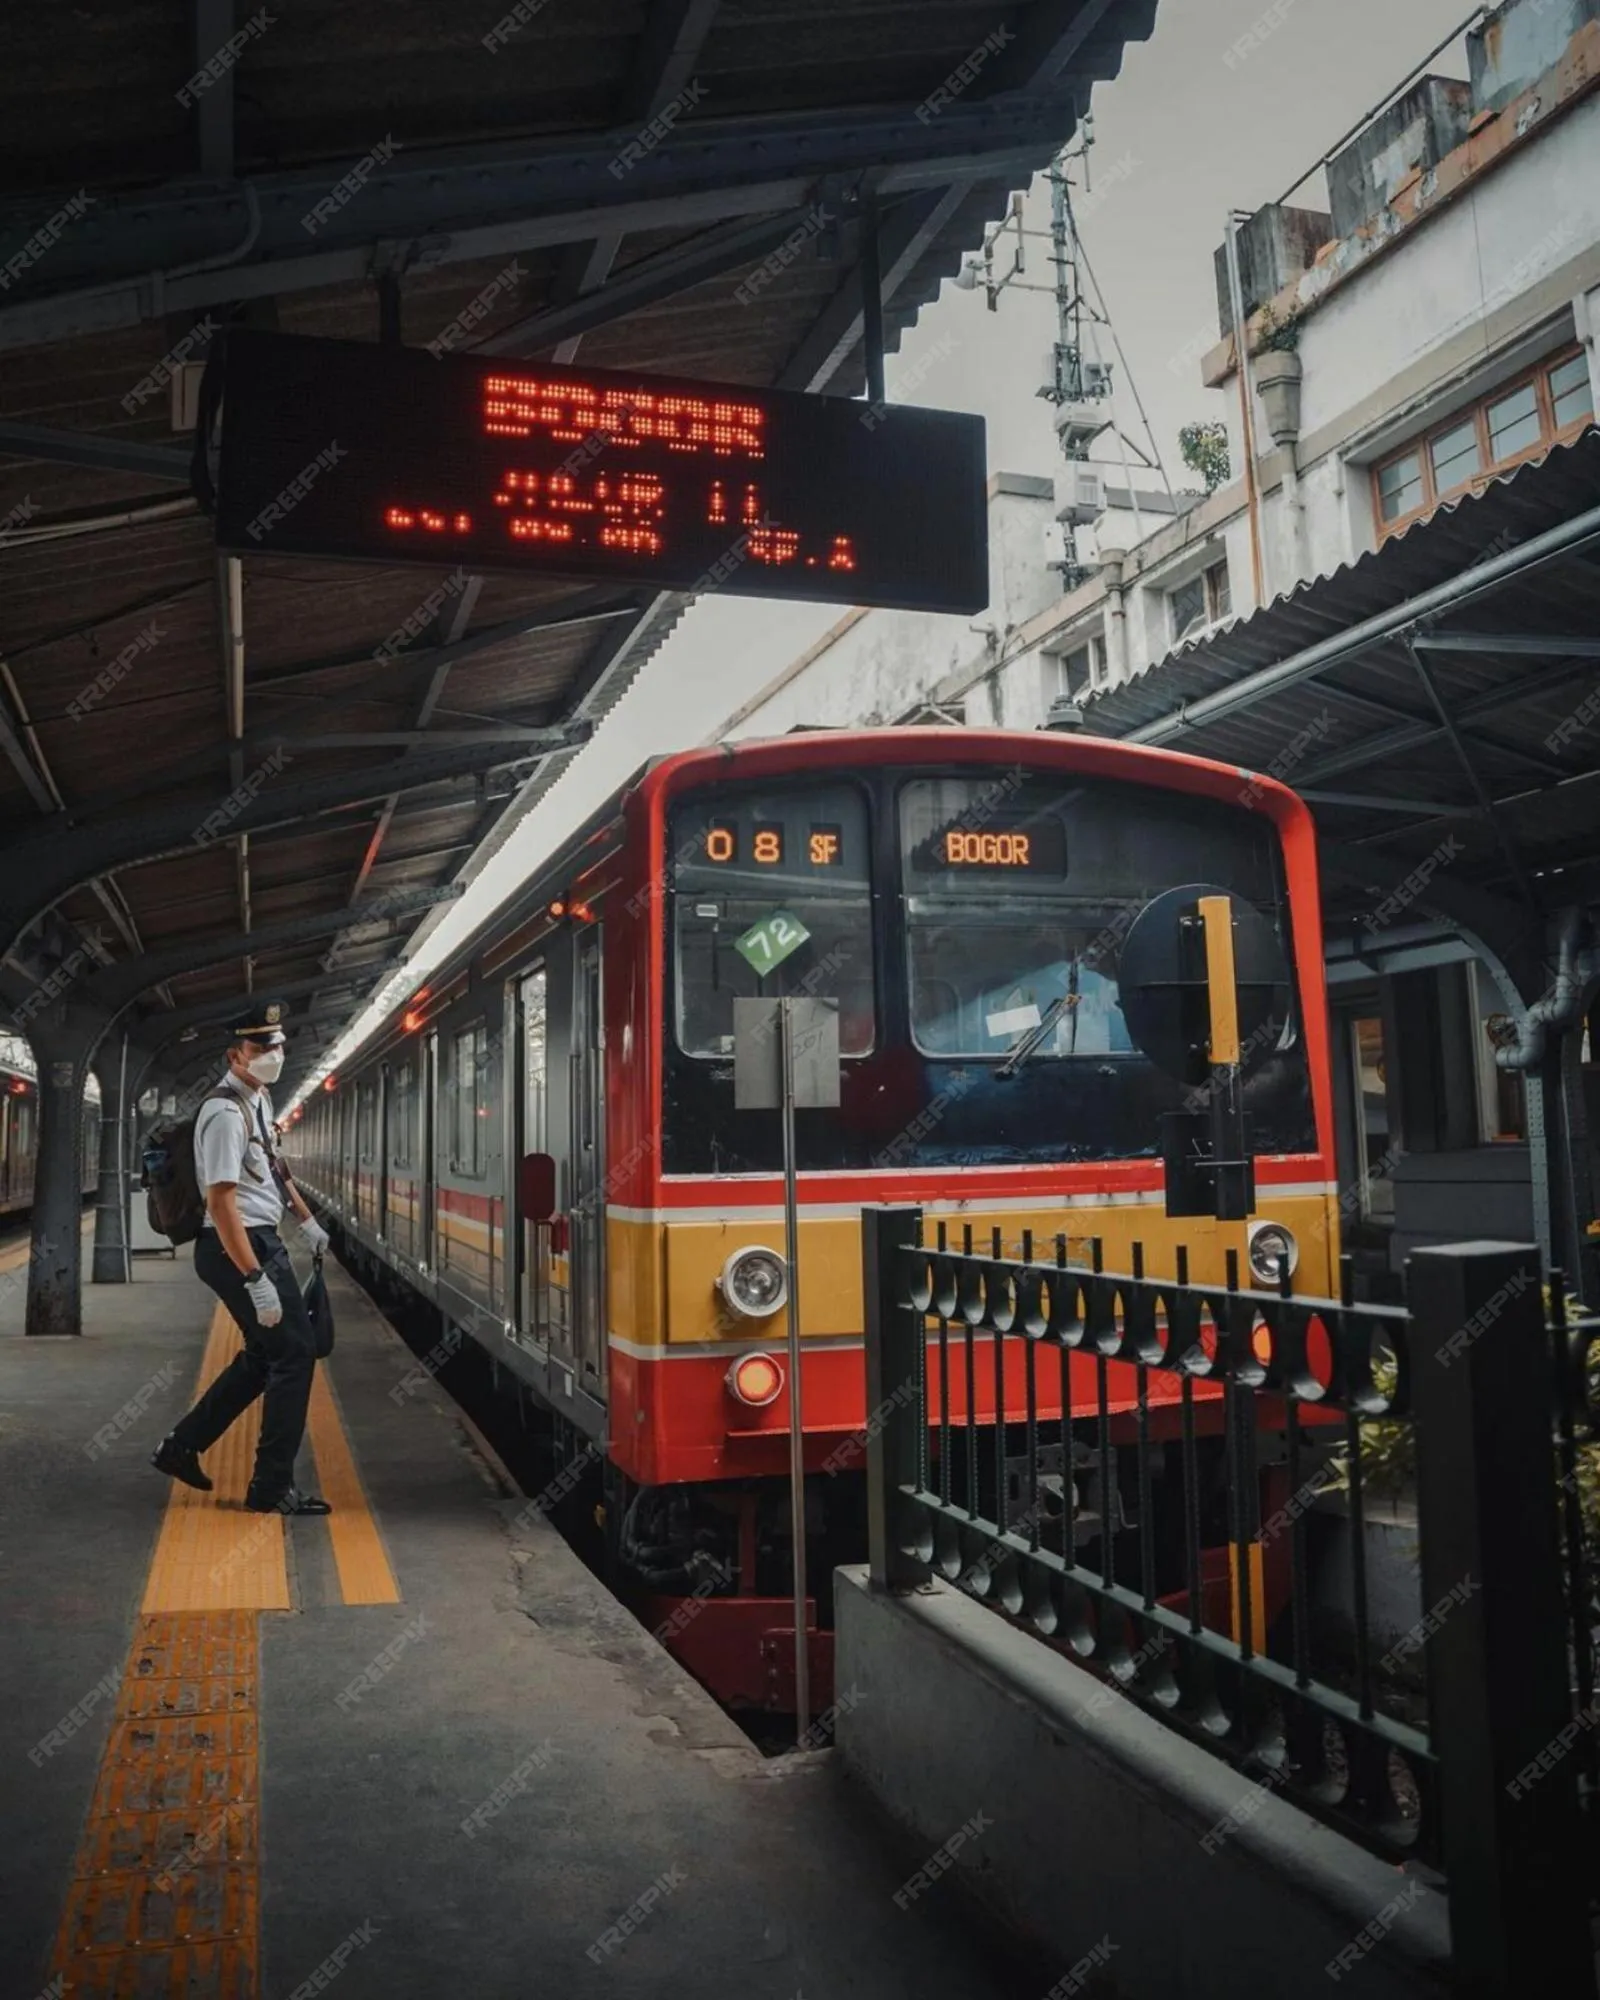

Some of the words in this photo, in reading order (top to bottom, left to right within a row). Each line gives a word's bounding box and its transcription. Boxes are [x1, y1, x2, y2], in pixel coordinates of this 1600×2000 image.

[486, 378, 764, 457] BOGOR
[810, 834, 837, 864] SF
[946, 832, 1029, 865] BOGOR
[746, 917, 798, 959] 72
